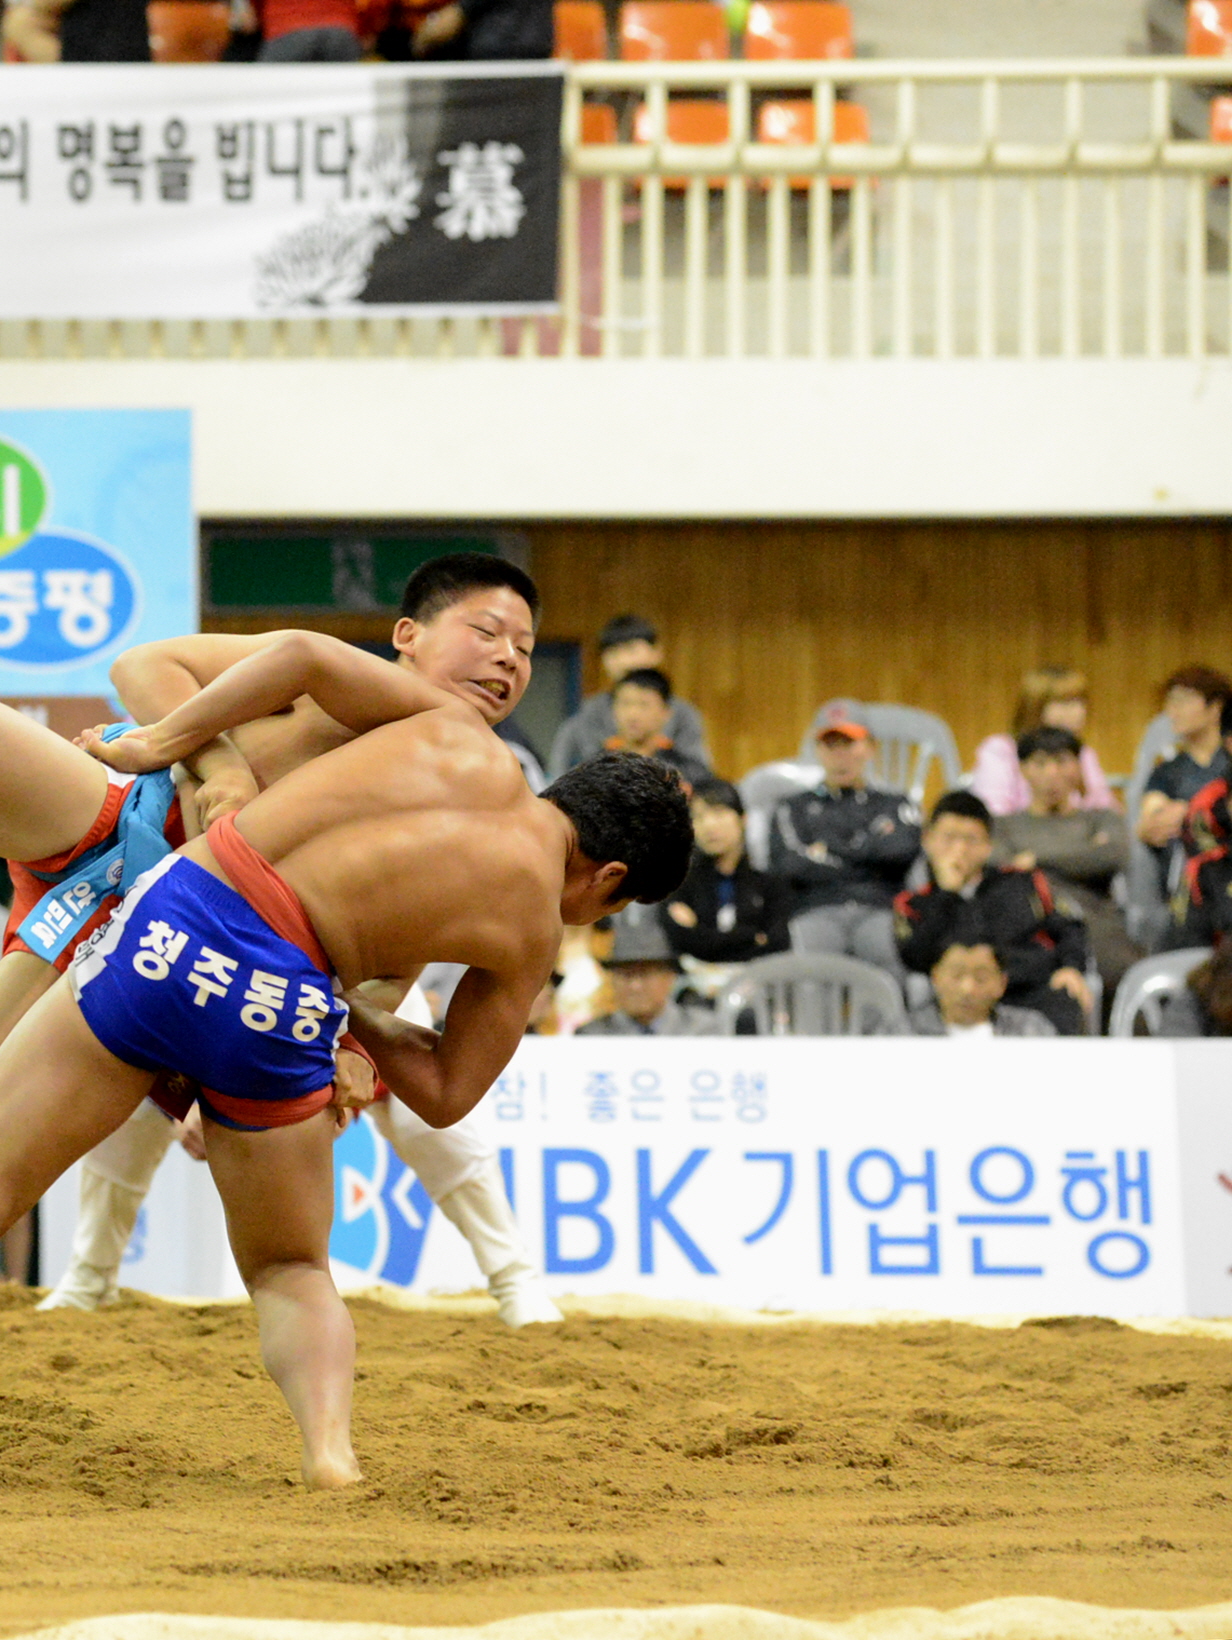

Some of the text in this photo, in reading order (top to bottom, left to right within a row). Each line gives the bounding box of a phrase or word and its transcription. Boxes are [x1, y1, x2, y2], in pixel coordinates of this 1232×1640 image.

[57, 120, 195, 202] 명복을
[436, 141, 525, 241] 慕
[132, 919, 331, 1043] 청주동중
[583, 1071, 665, 1123] 좋은
[687, 1071, 768, 1123] 은행
[742, 1146, 1152, 1280] 기업은행
